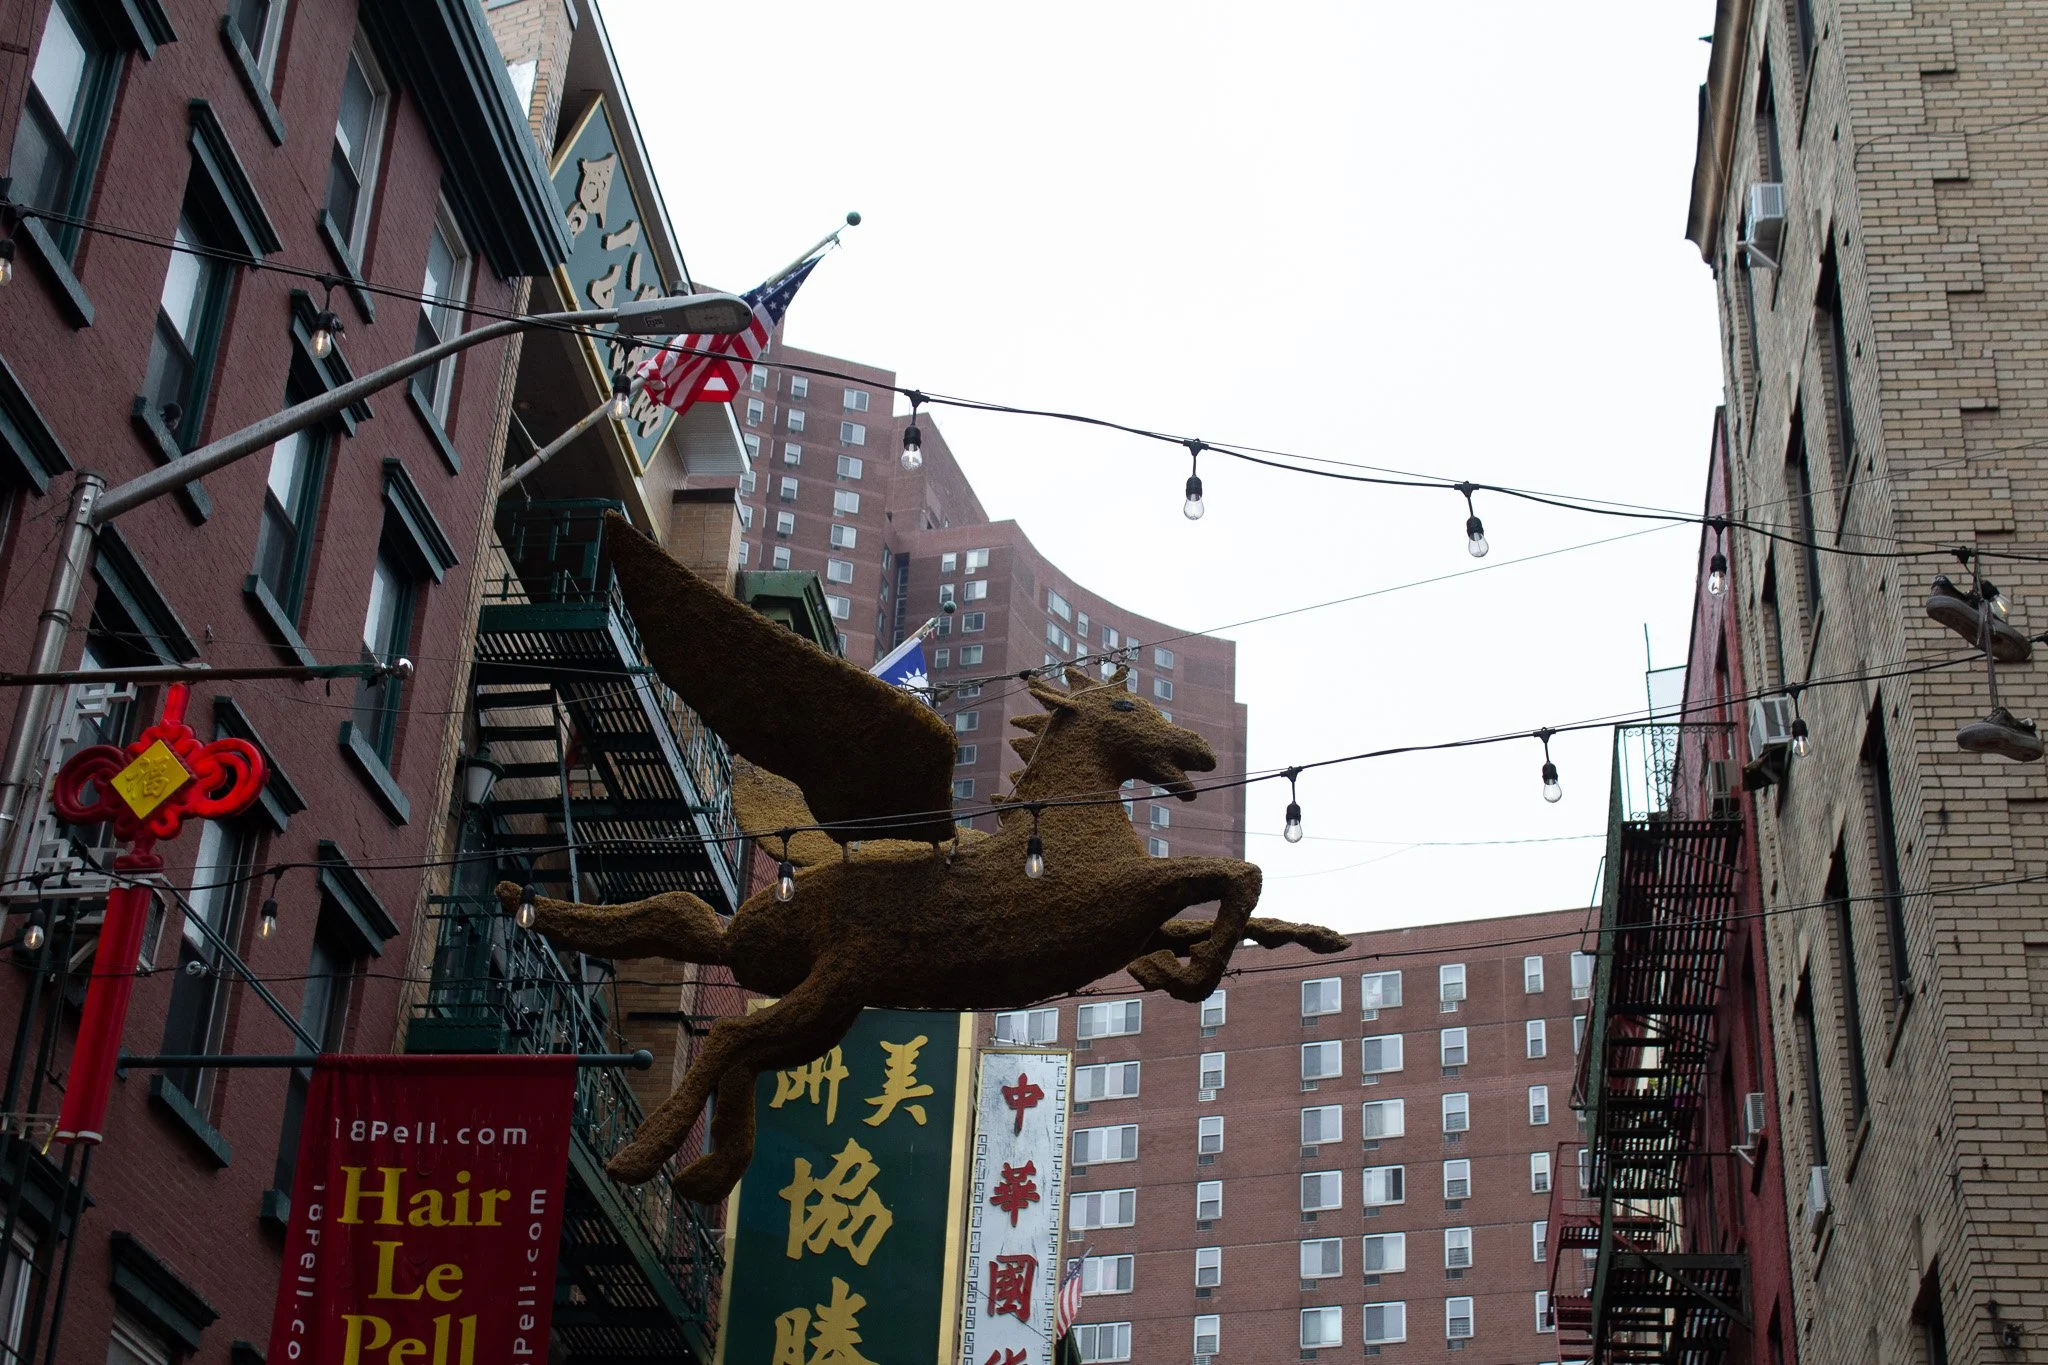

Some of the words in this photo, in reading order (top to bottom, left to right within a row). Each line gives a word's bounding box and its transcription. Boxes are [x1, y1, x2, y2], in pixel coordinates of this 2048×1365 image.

[335, 1118, 528, 1145] 18Pell.com
[336, 1165, 511, 1227] Hair
[982, 1072, 1045, 1365] 中華國
[367, 1240, 464, 1301] Le
[513, 1188, 548, 1365] Pell.com
[341, 1313, 477, 1365] Pell
